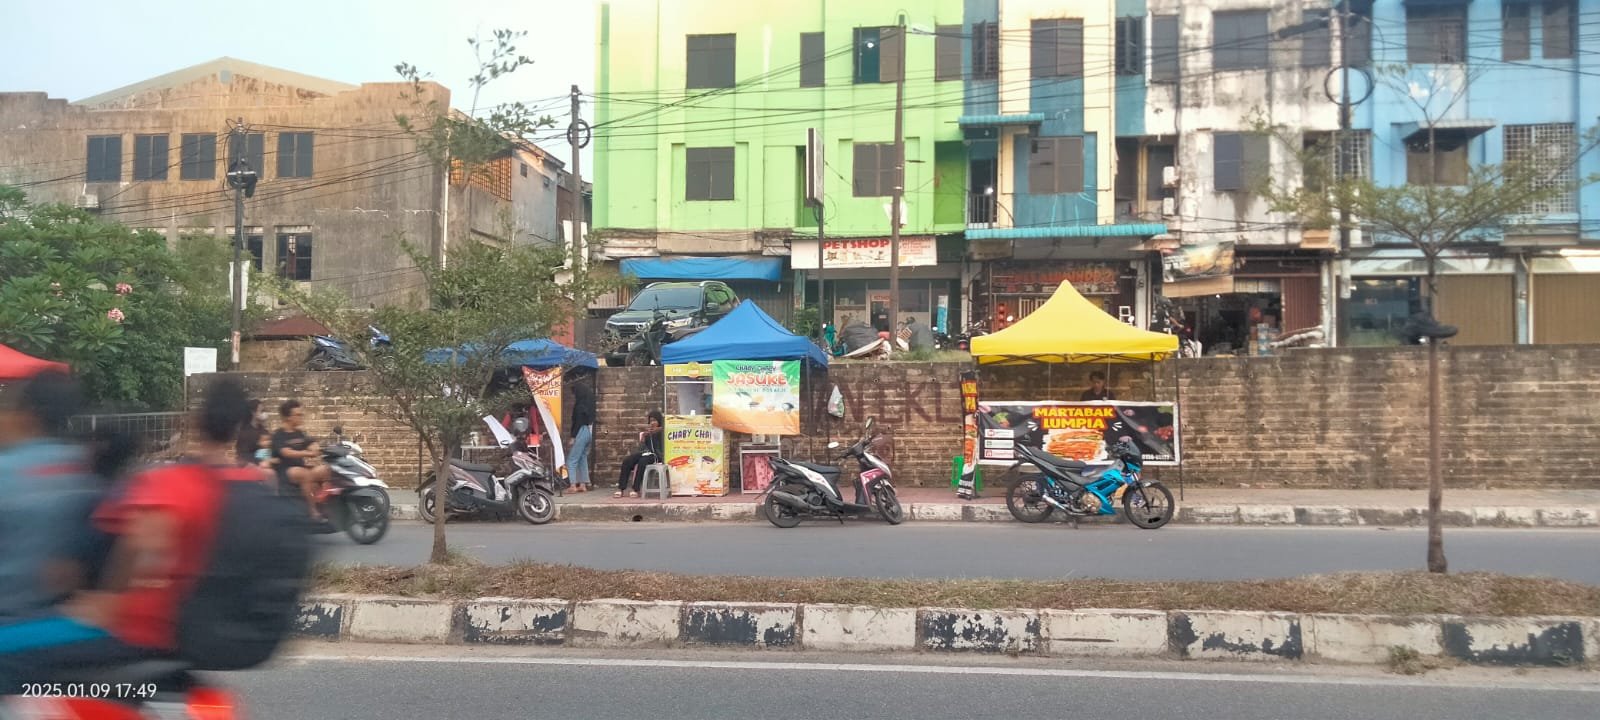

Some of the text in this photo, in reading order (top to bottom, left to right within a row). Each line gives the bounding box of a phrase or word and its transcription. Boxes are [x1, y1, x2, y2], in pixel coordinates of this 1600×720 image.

[823, 239, 890, 250] PETSHOP
[727, 373, 787, 385] JASUKE
[1034, 407, 1114, 417] MARTABAK
[1043, 418, 1105, 429] LUMPIA
[668, 429, 692, 440] CHABY
